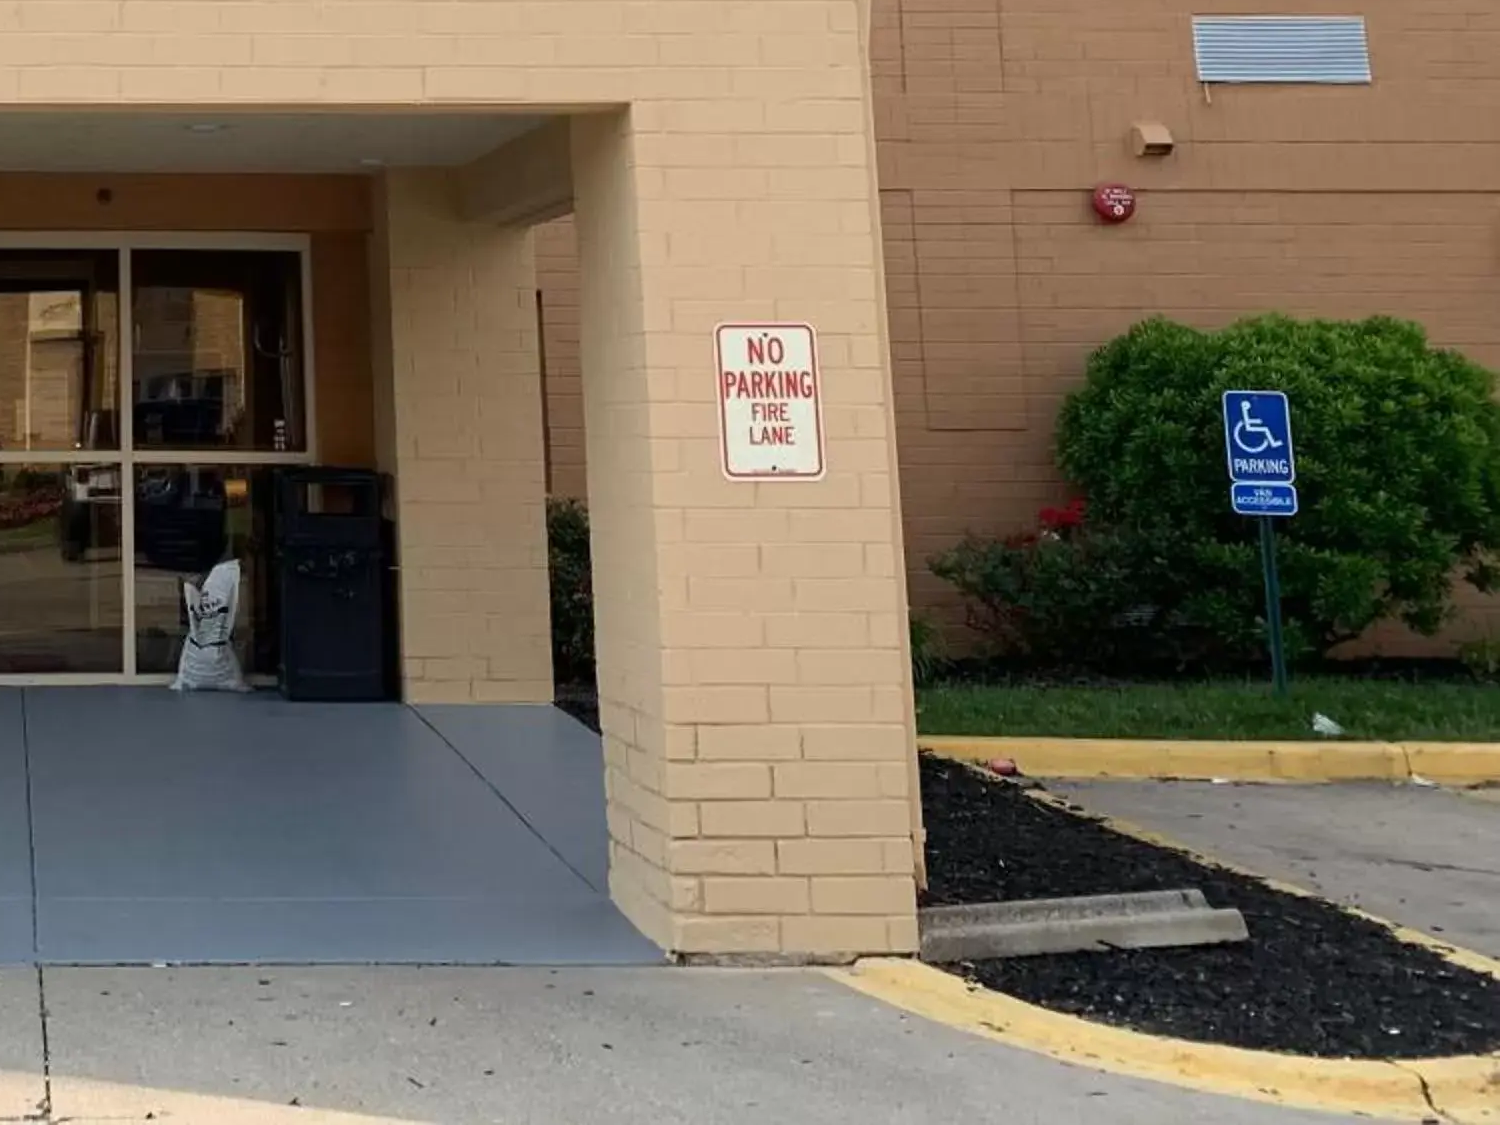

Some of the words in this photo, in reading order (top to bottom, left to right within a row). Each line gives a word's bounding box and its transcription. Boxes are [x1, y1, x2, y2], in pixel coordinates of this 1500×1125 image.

[747, 337, 784, 364] NO
[724, 371, 813, 399] PARKING
[751, 403, 790, 422] FIRE
[750, 426, 796, 446] LANE
[1233, 458, 1289, 474] PARKING
